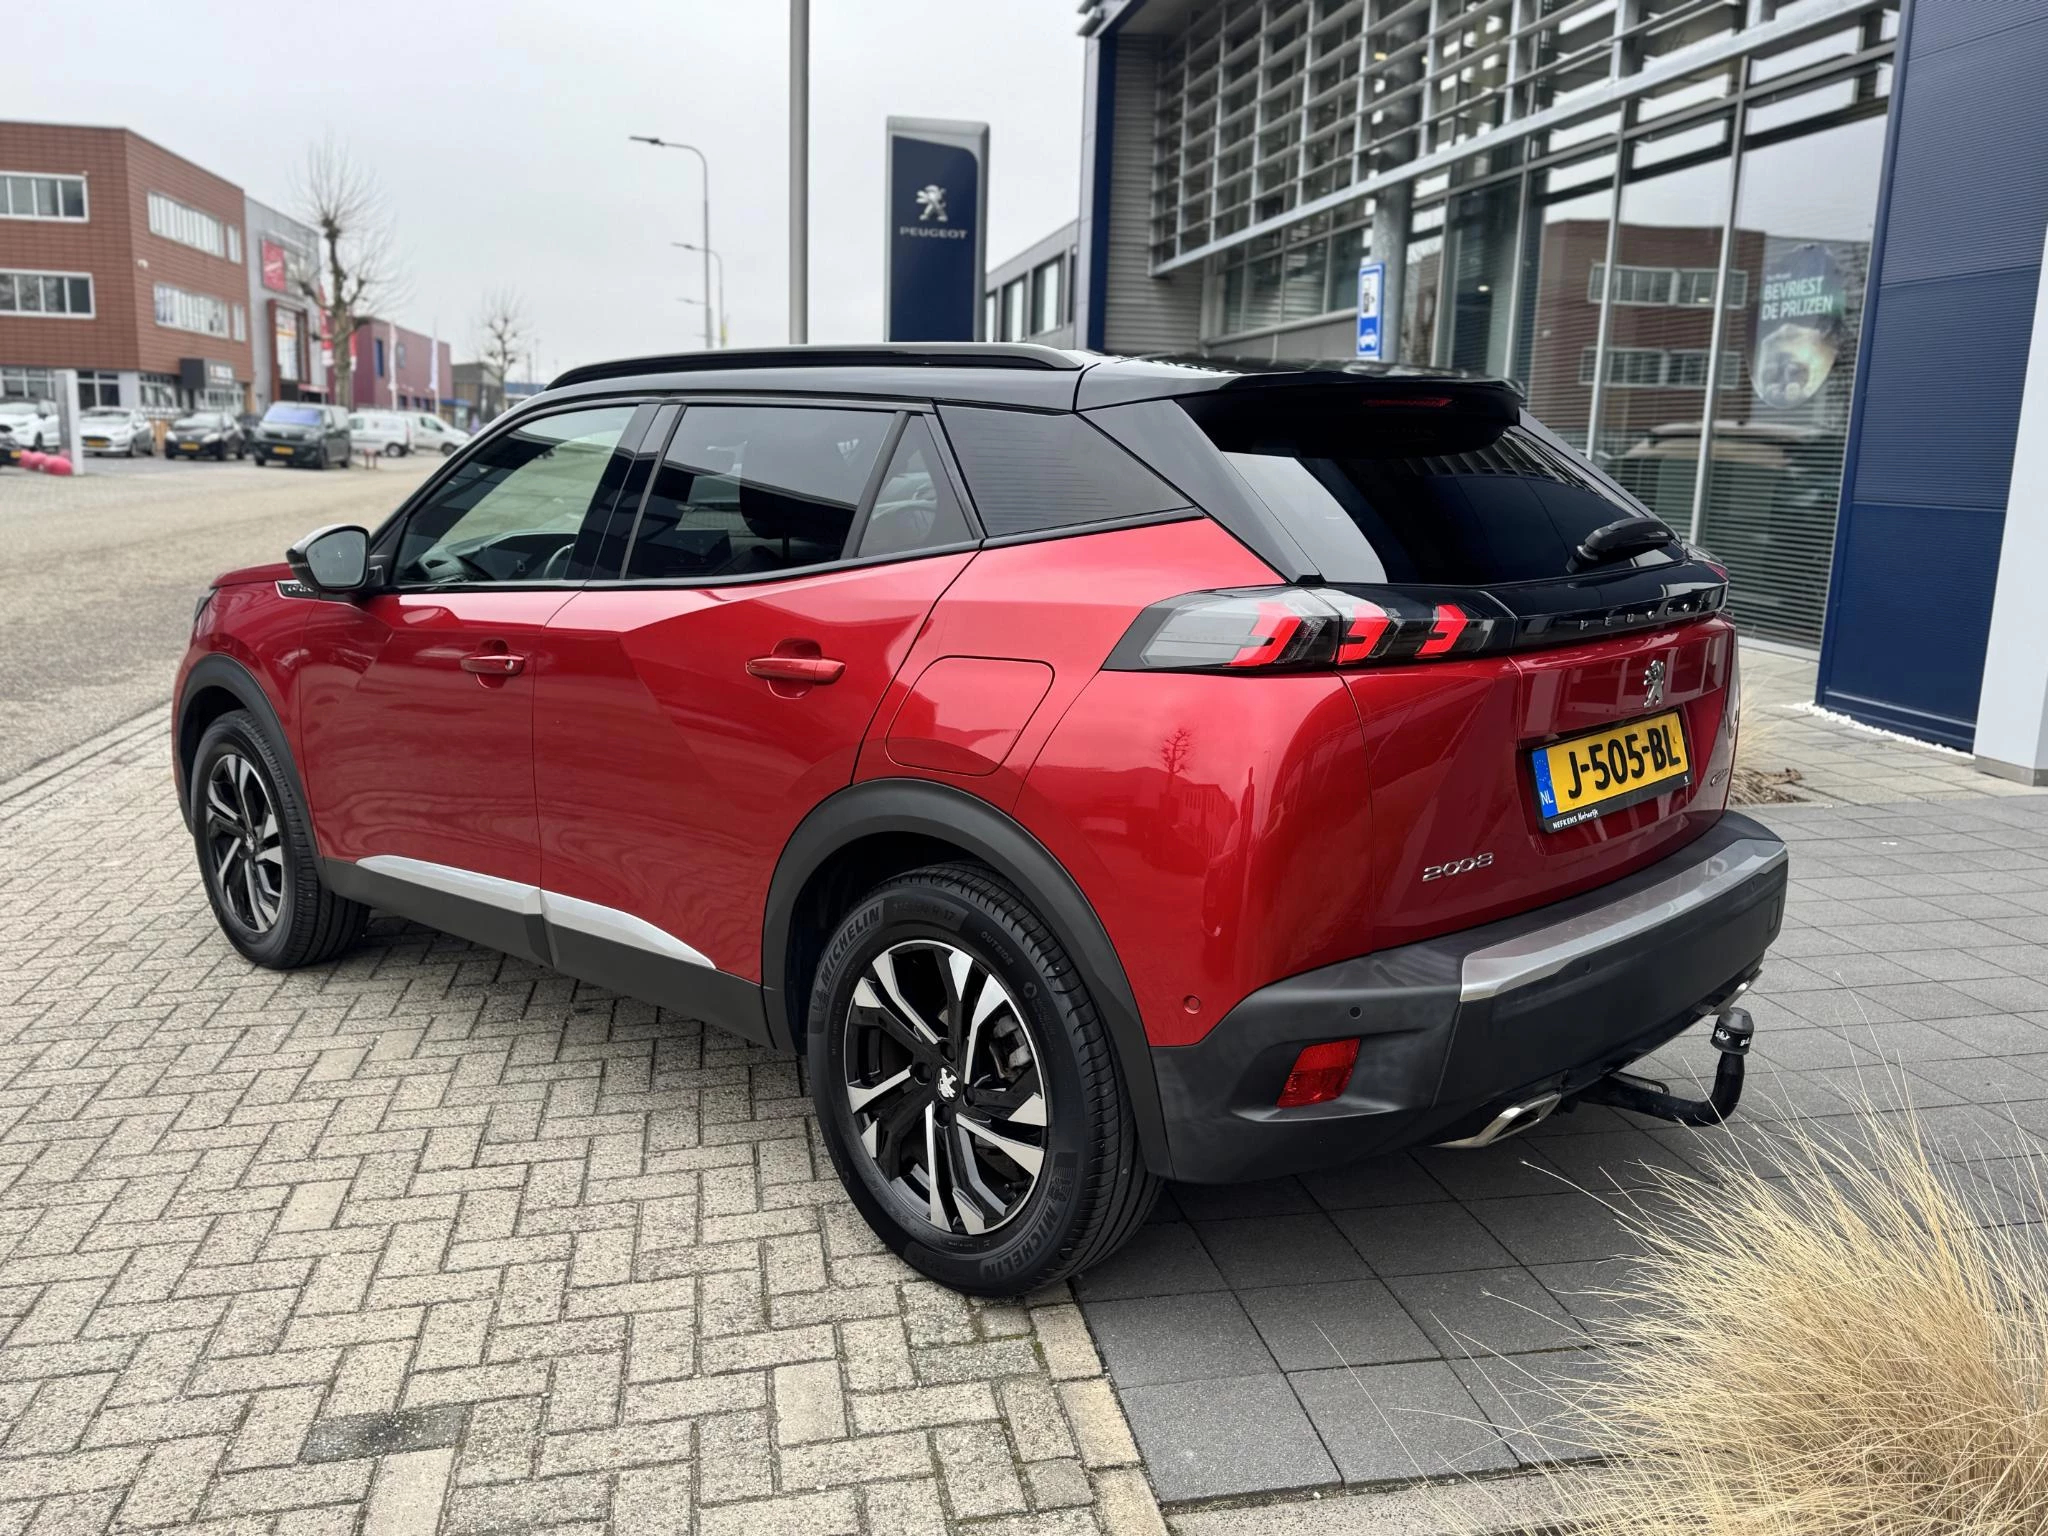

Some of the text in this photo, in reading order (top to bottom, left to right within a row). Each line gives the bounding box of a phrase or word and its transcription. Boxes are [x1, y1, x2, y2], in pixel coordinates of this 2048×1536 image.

[900, 226, 968, 239] PEUGEOT
[1763, 276, 1824, 301] BEVRIEST
[1761, 295, 1834, 320] DE PRIJZEN
[1568, 725, 1682, 799] J-505-BL
[1540, 790, 1554, 806] NL
[1552, 815, 1578, 829] NEFKENS
[1422, 852, 1494, 882] 2008
[821, 906, 881, 988] MICHELIN
[984, 1206, 1059, 1280] MICHELIN
